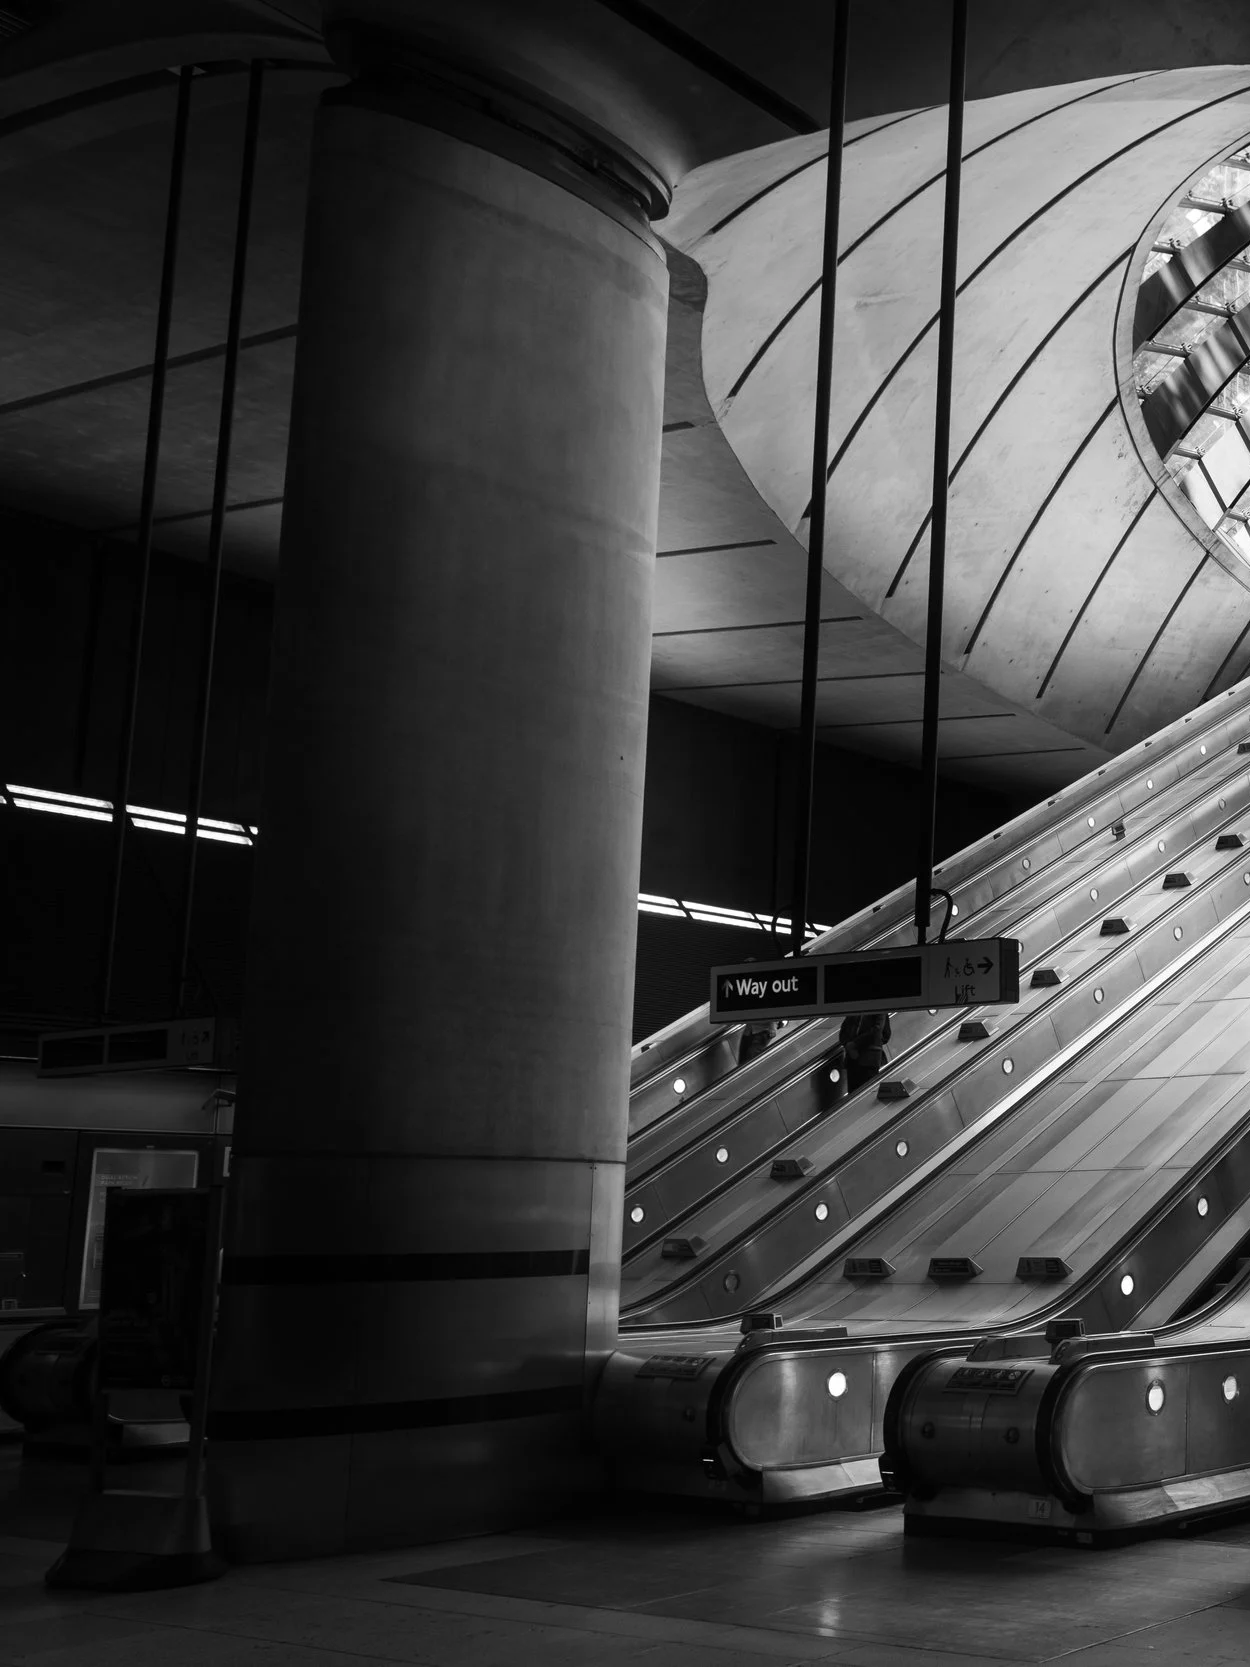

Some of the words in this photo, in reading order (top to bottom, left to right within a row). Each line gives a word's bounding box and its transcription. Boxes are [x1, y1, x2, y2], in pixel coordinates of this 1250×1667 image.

[736, 978, 768, 999] Way
[772, 976, 799, 993] out
[954, 984, 976, 997] Lift
[1035, 1501, 1046, 1514] 14
